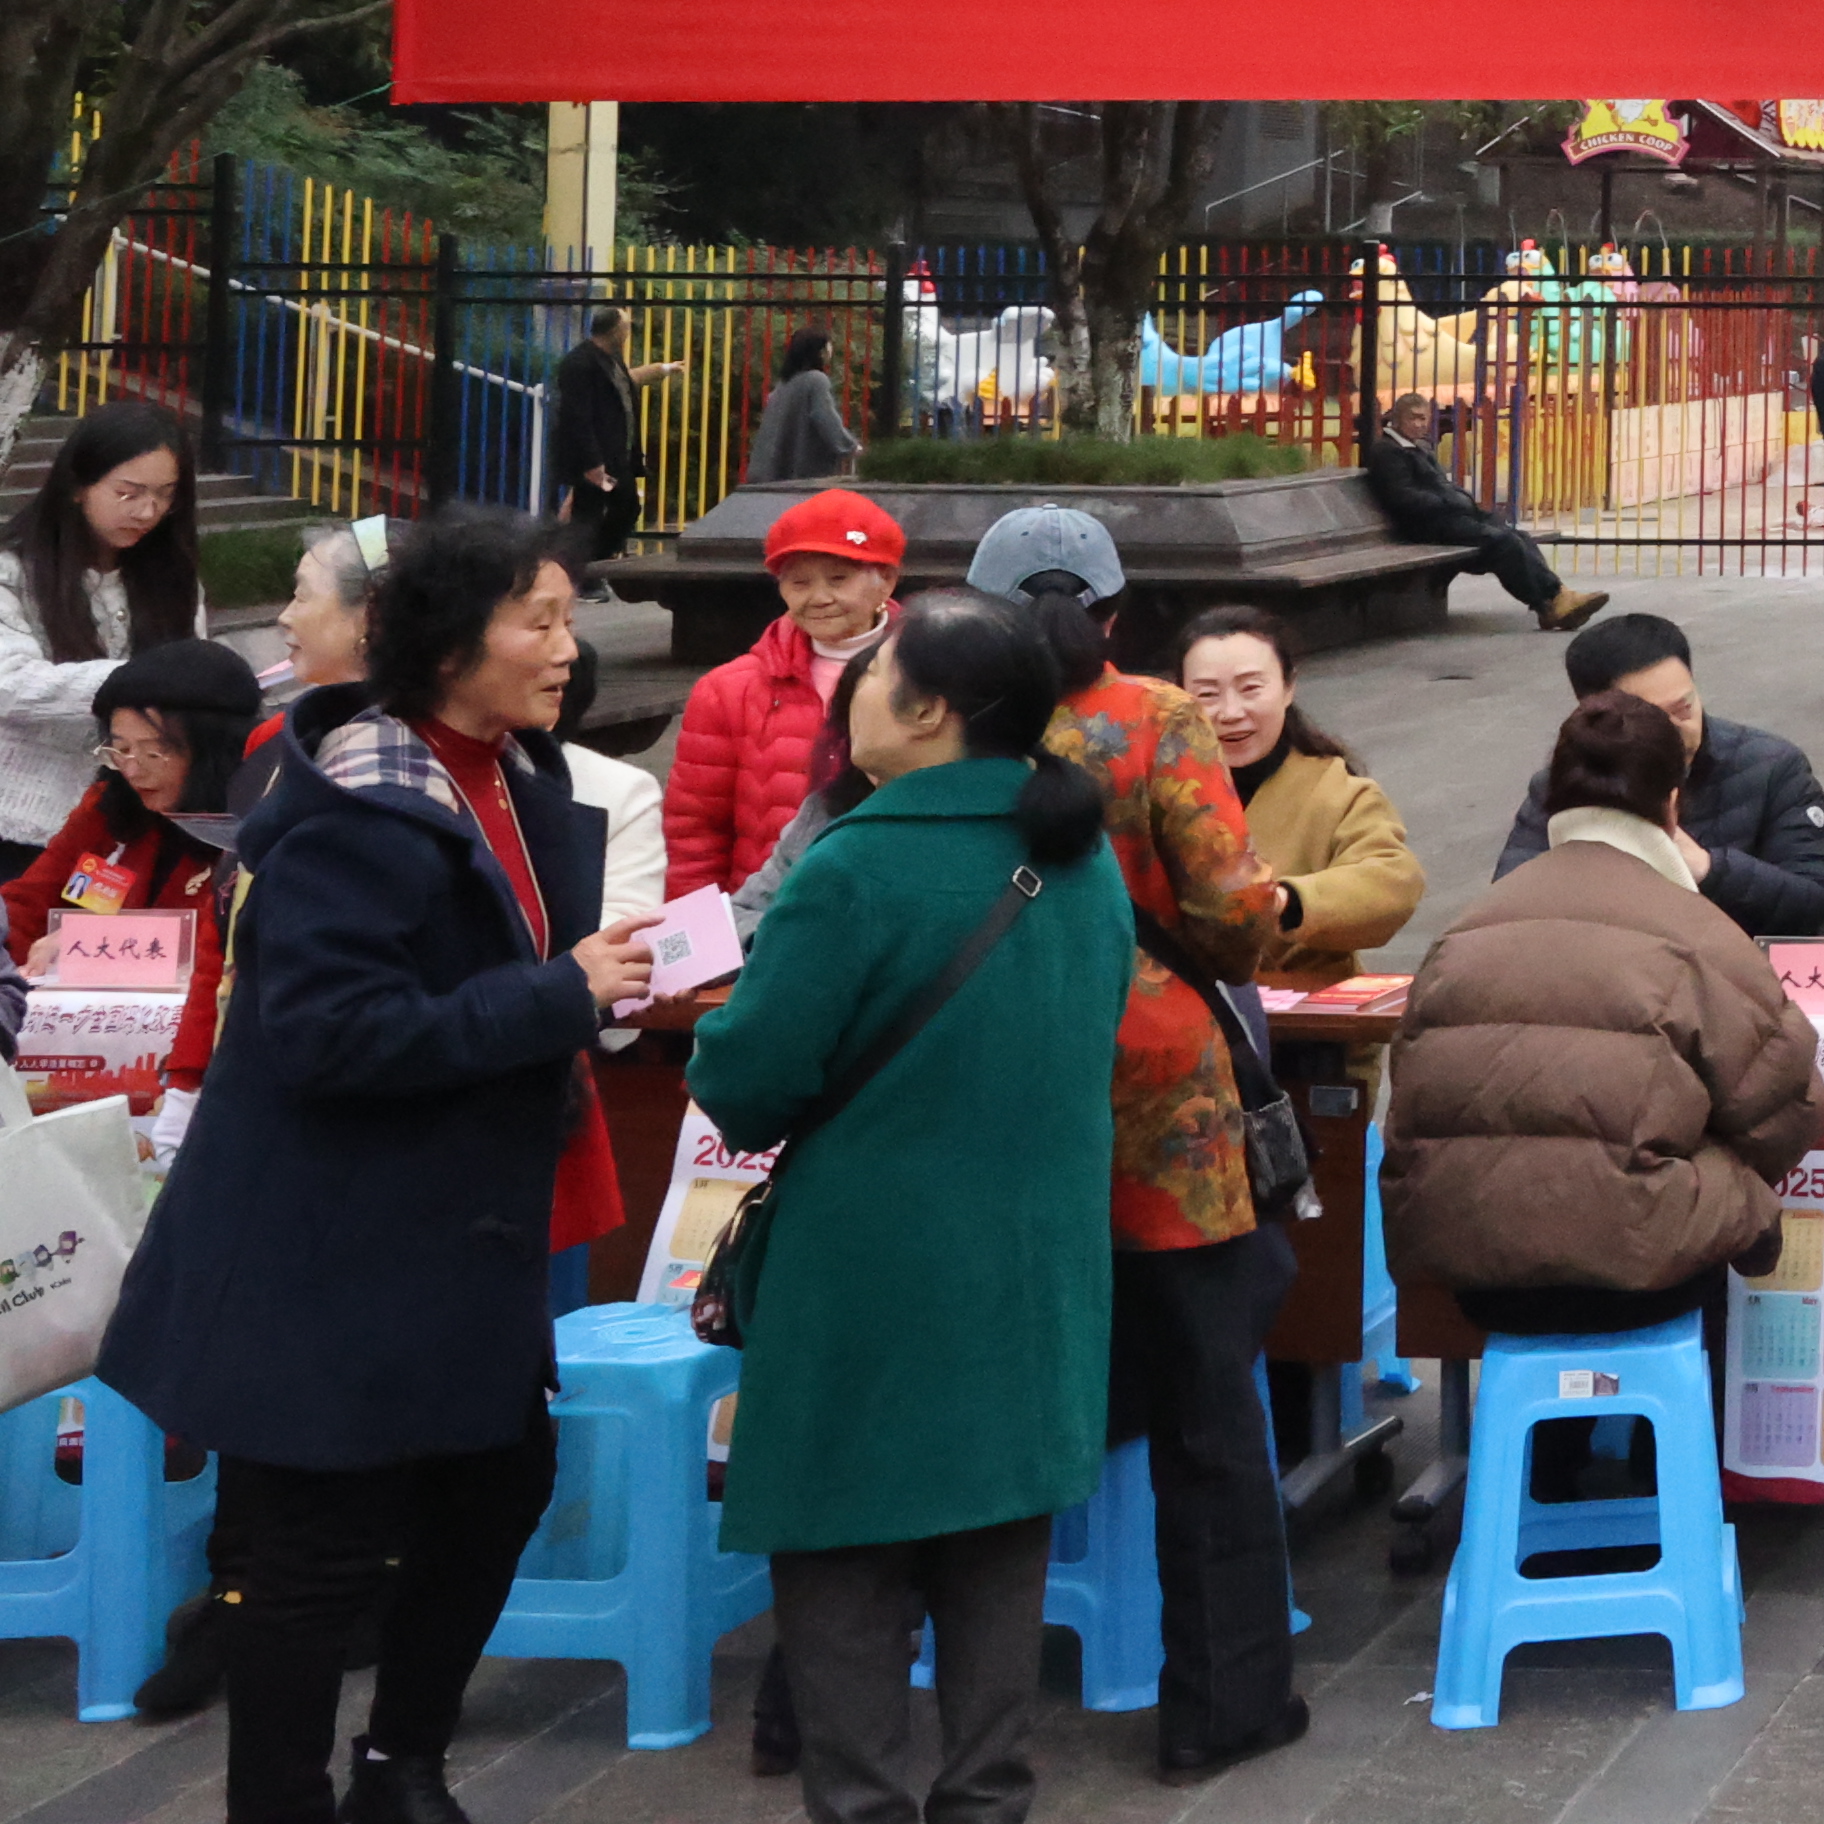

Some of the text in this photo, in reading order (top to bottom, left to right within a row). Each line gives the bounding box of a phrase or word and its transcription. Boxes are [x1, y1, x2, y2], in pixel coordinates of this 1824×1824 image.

[1580, 132, 1674, 153] CHICKEN COOP
[66, 936, 168, 960] 人大代表
[12, 1286, 45, 1307] Club
